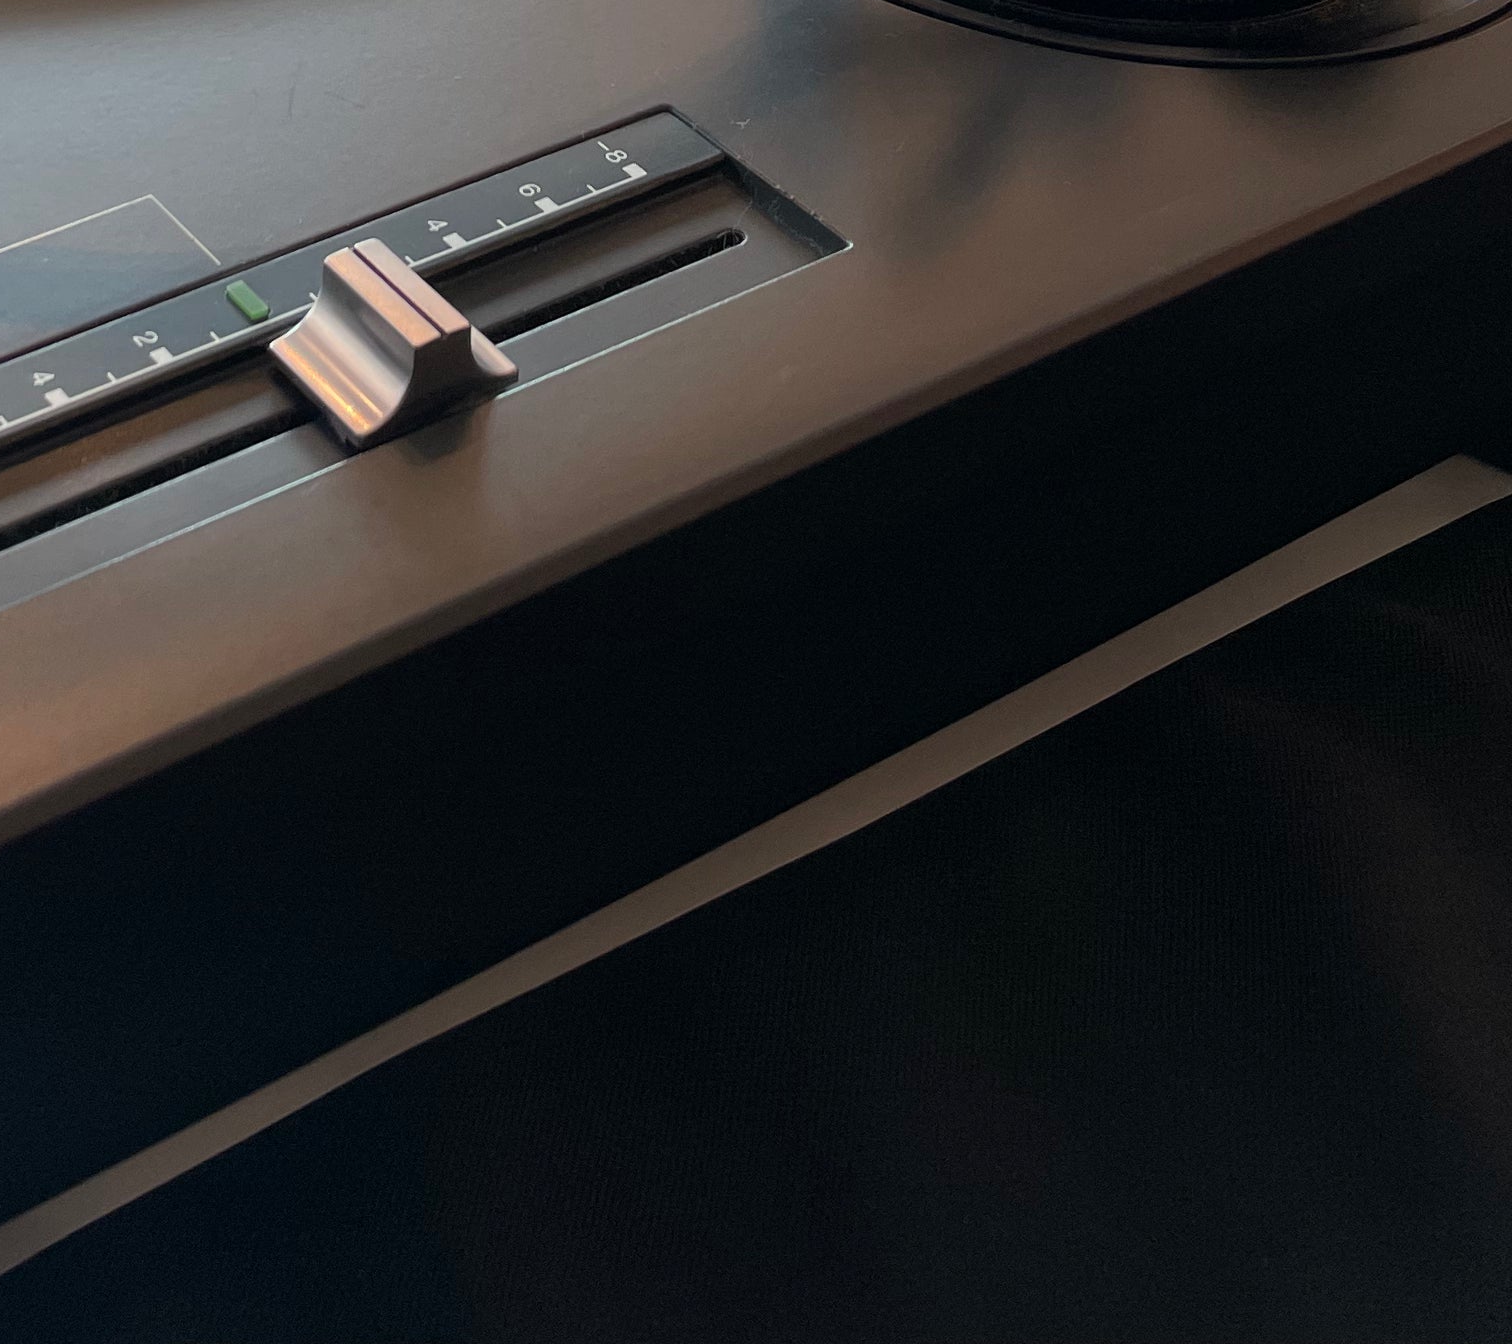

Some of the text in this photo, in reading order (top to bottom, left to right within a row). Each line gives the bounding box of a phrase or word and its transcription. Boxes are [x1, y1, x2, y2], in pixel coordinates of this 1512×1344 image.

[32, 371, 55, 387] 4
[132, 330, 159, 348] 2
[427, 219, 448, 232] 4
[519, 183, 541, 197] 6
